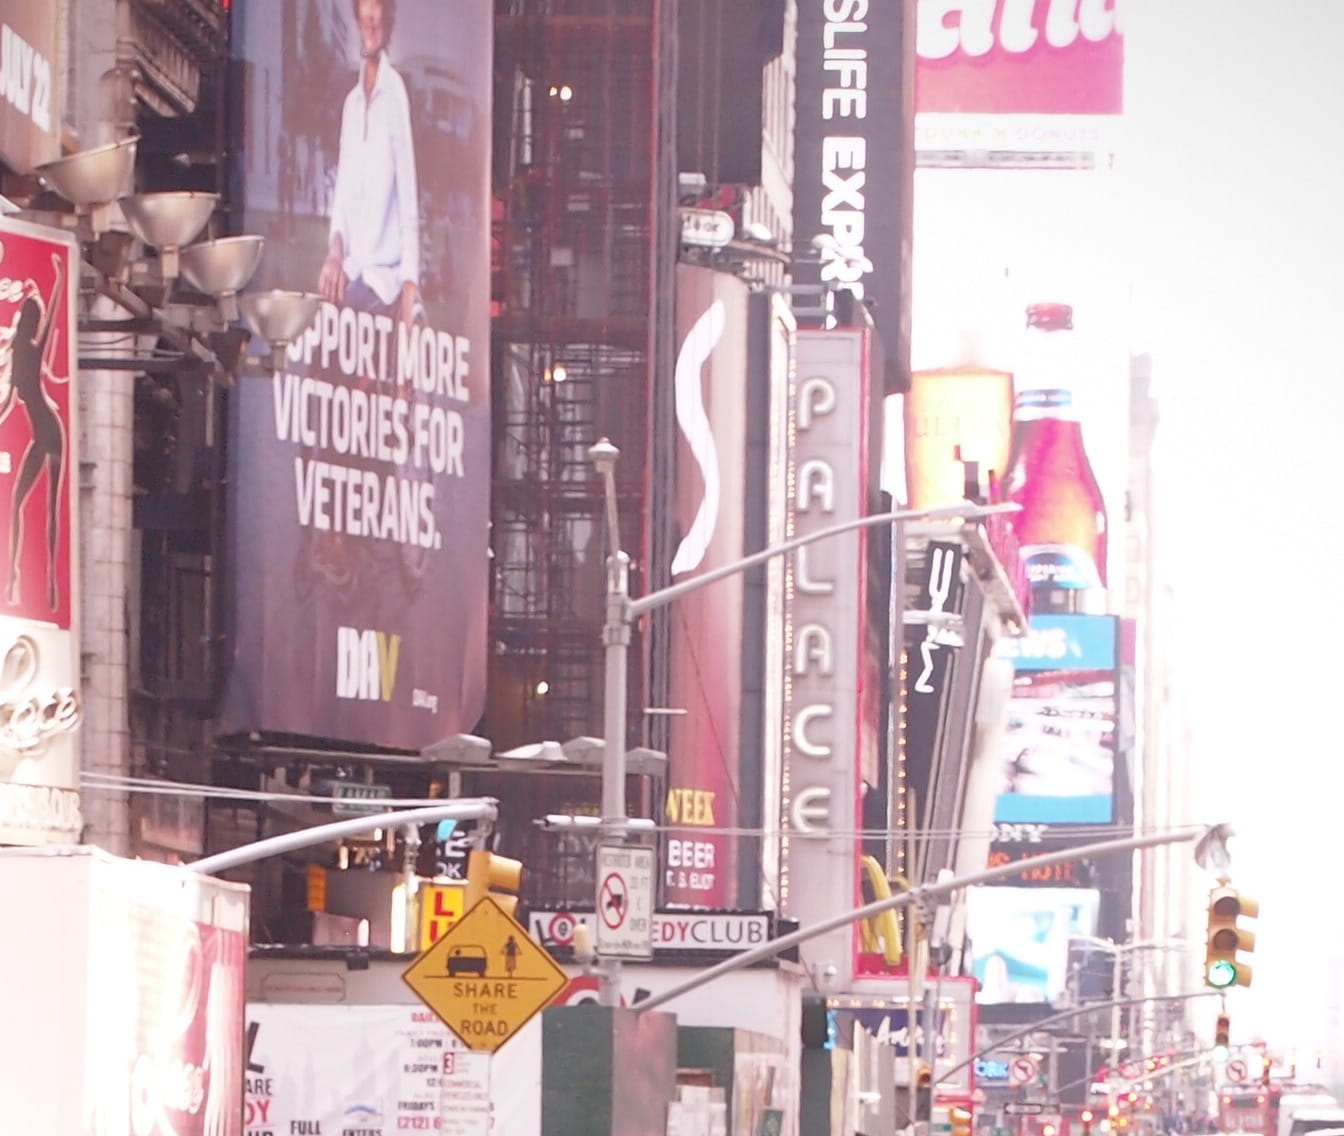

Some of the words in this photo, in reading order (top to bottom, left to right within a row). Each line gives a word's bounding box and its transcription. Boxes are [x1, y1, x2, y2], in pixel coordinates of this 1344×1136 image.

[32, 52, 51, 131] 22
[286, 302, 393, 378] UPPORT
[396, 323, 471, 403] MORE
[272, 370, 407, 465] VICTORIES
[413, 407, 465, 478] FOR
[293, 458, 442, 551] VETERANS.
[791, 376, 839, 842] PALACE
[335, 626, 402, 703] DAV
[668, 840, 716, 868] BEER
[453, 982, 519, 999] SHARE
[460, 1019, 509, 1037] ROAD
[472, 1003, 497, 1016] THE
[289, 1120, 322, 1136] FULL
